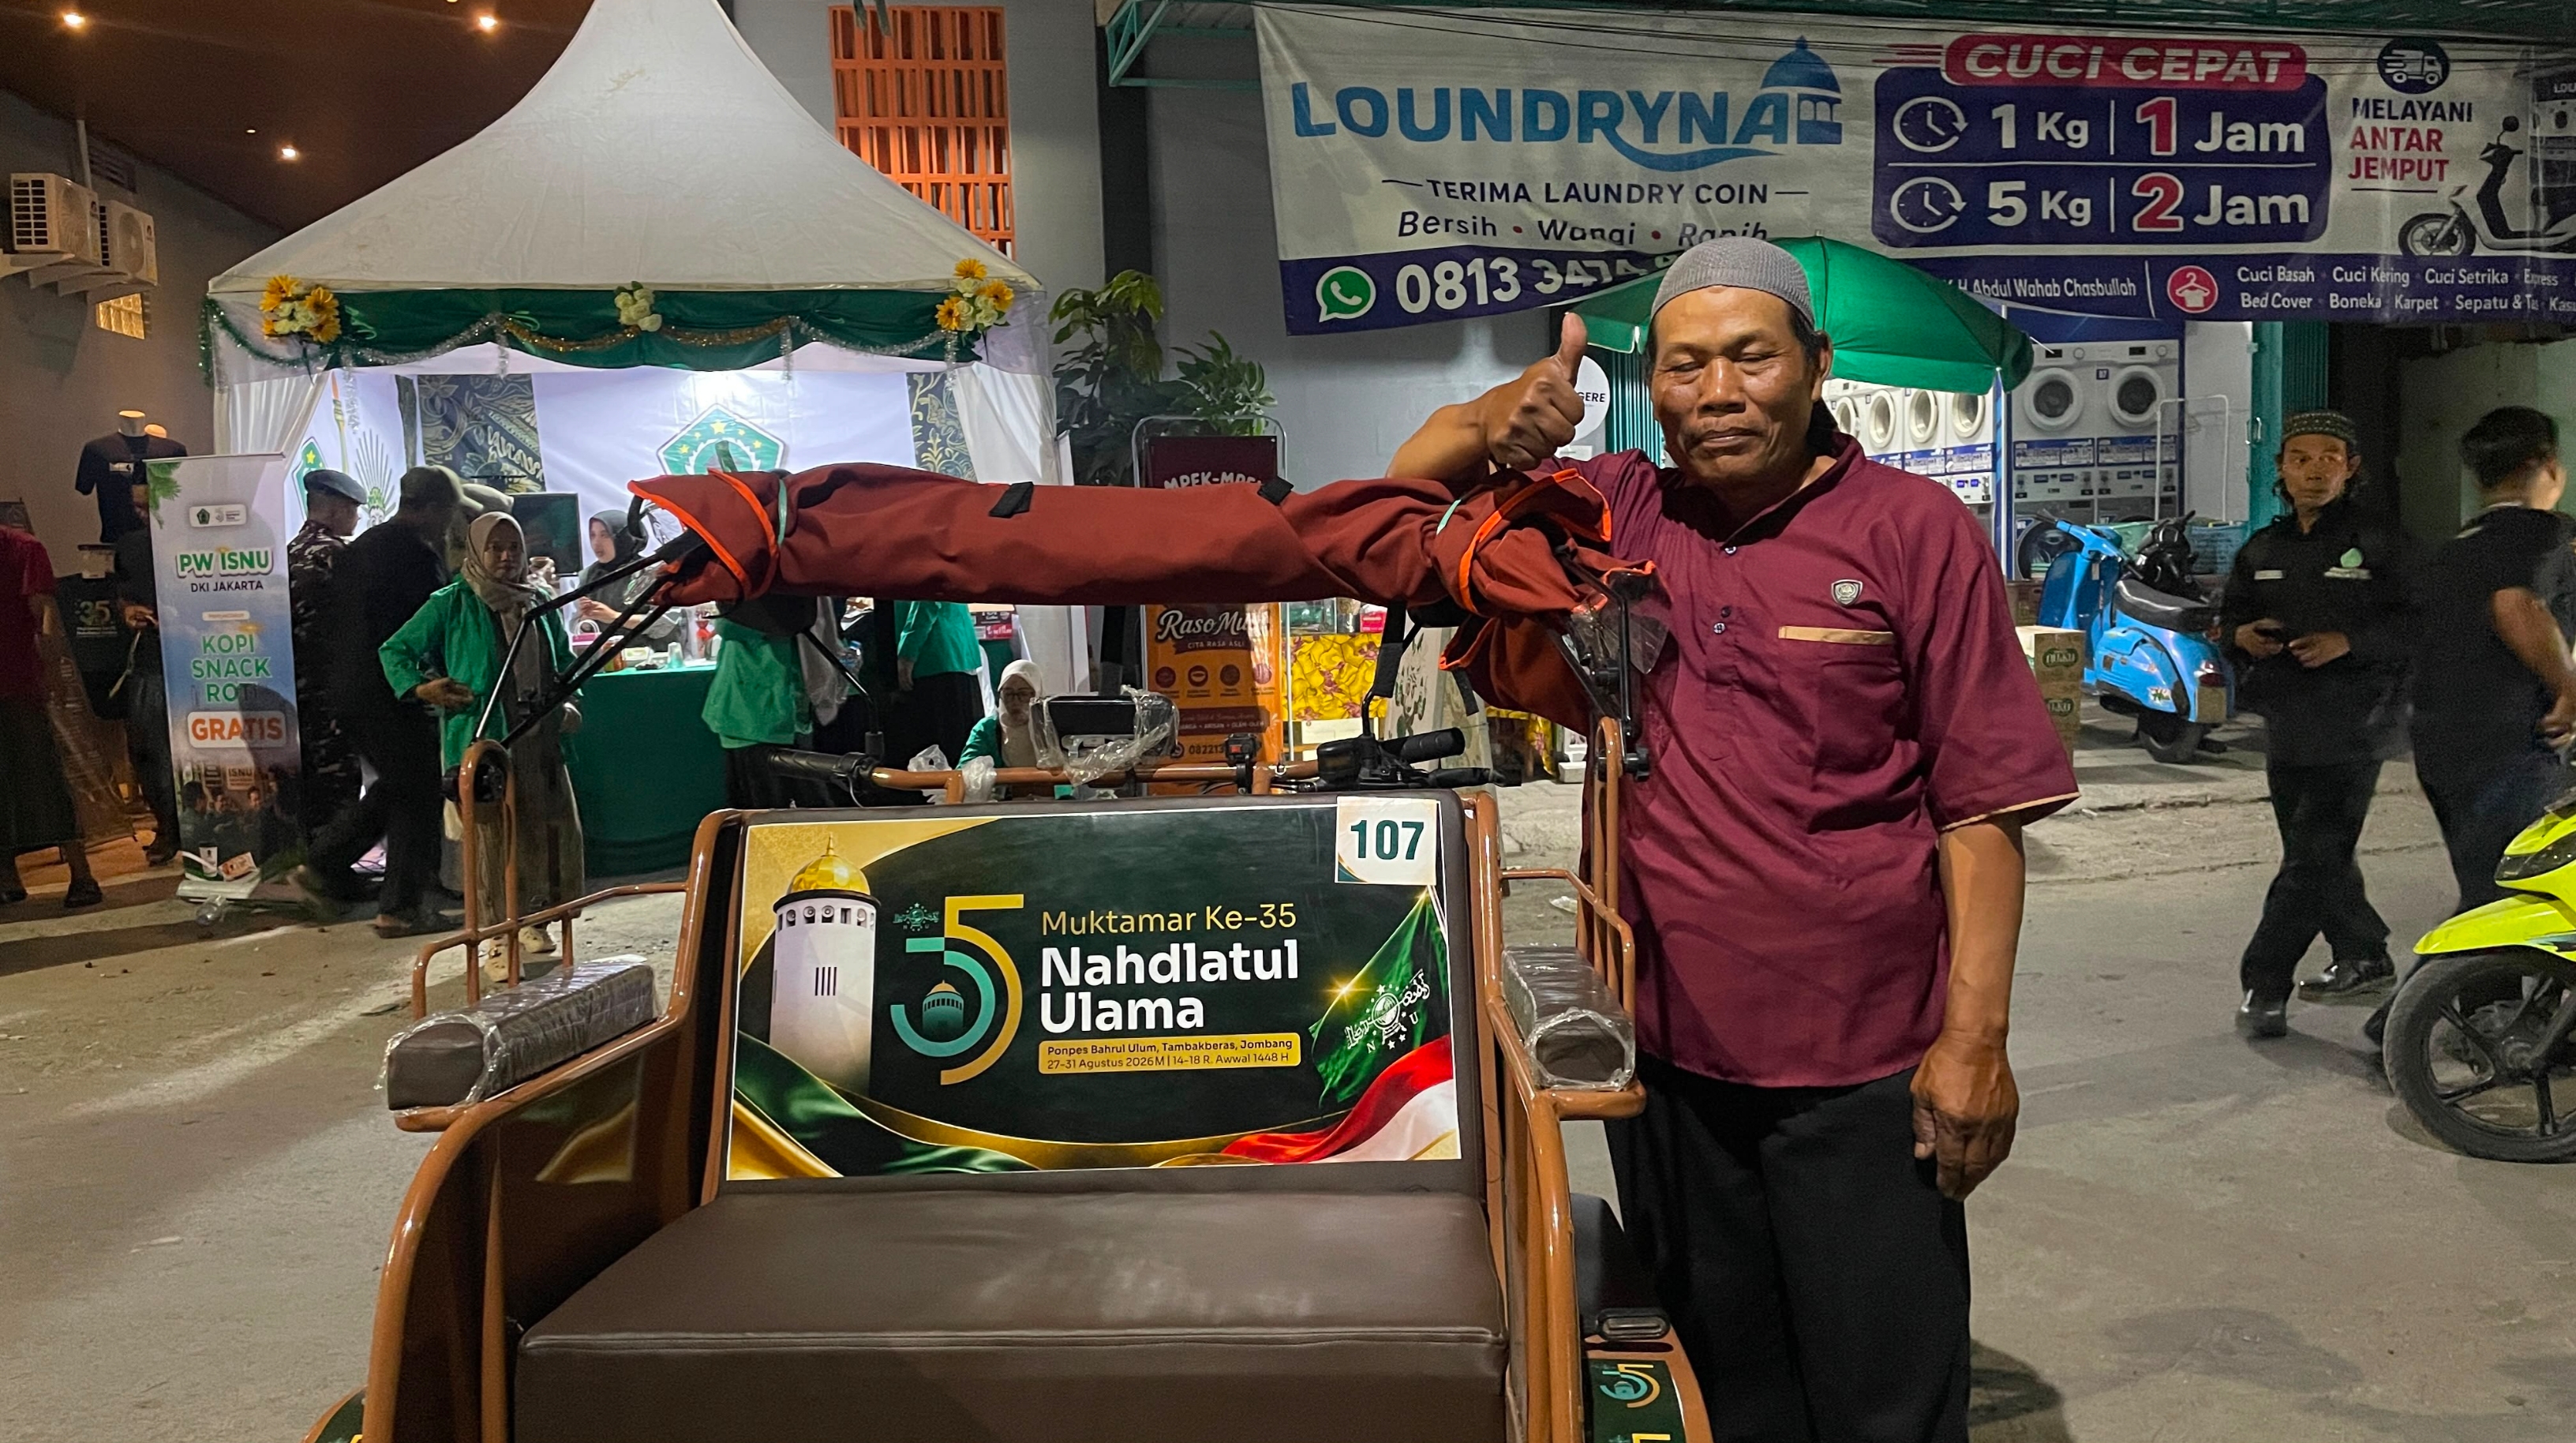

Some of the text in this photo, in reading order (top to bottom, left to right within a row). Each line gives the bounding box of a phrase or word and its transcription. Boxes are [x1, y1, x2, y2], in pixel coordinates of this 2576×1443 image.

[1965, 44, 2290, 84] CUCI CEPAT
[2352, 97, 2473, 122] MELAYANI
[1292, 81, 1788, 171] LOUNDRYNA
[1991, 97, 2305, 156] 1 Kg 1 Jam
[2349, 126, 2443, 152] ANTAR
[2348, 157, 2450, 182] JEMPUT
[1427, 180, 1769, 205] TERIMA LAUNDRY COIN
[1987, 172, 2310, 232] 5 Kg 2 Jam
[1398, 211, 1497, 238] Bersih
[1395, 257, 1522, 314] 0813
[1973, 279, 2012, 298] Abdul
[2013, 279, 2061, 298] Wahab
[2064, 278, 2137, 298] Chasbullah
[2237, 266, 2273, 283] Cuci
[2278, 266, 2316, 283] Basah
[2332, 267, 2367, 283] Cuci
[2371, 267, 2410, 287] Kering
[2424, 268, 2455, 285] Cuci
[2458, 268, 2509, 285] Setrika
[2241, 293, 2269, 309] Bed
[2271, 293, 2313, 309] Cover
[2330, 293, 2382, 309] Boneka
[2394, 294, 2439, 313] Karpet
[2455, 295, 2508, 313] Sepatu
[179, 550, 270, 572] PW ISNU
[190, 580, 264, 593] DKI JAKARTA
[1157, 609, 1216, 641] Raso
[202, 633, 255, 654] KOPI
[191, 658, 271, 680] SNACK
[191, 718, 284, 741] GRATIS
[228, 768, 253, 777] ISNU
[1350, 819, 1425, 860] 107
[1042, 902, 1297, 936] Muktamar Ke-35
[1041, 938, 1299, 988] Nahdlatul
[1040, 991, 1205, 1034] Ulama
[1047, 1039, 1293, 1056] Ponpes Bahrul Ulum, Tambakberas, Jombang
[1047, 1059, 1076, 1070] 27-31
[1078, 1058, 1124, 1070] Agustus
[1173, 1055, 1201, 1066] 14-18
[1215, 1053, 1251, 1064] Awwal
[1253, 1052, 1279, 1063] 1448
[1281, 1052, 1289, 1063] H
